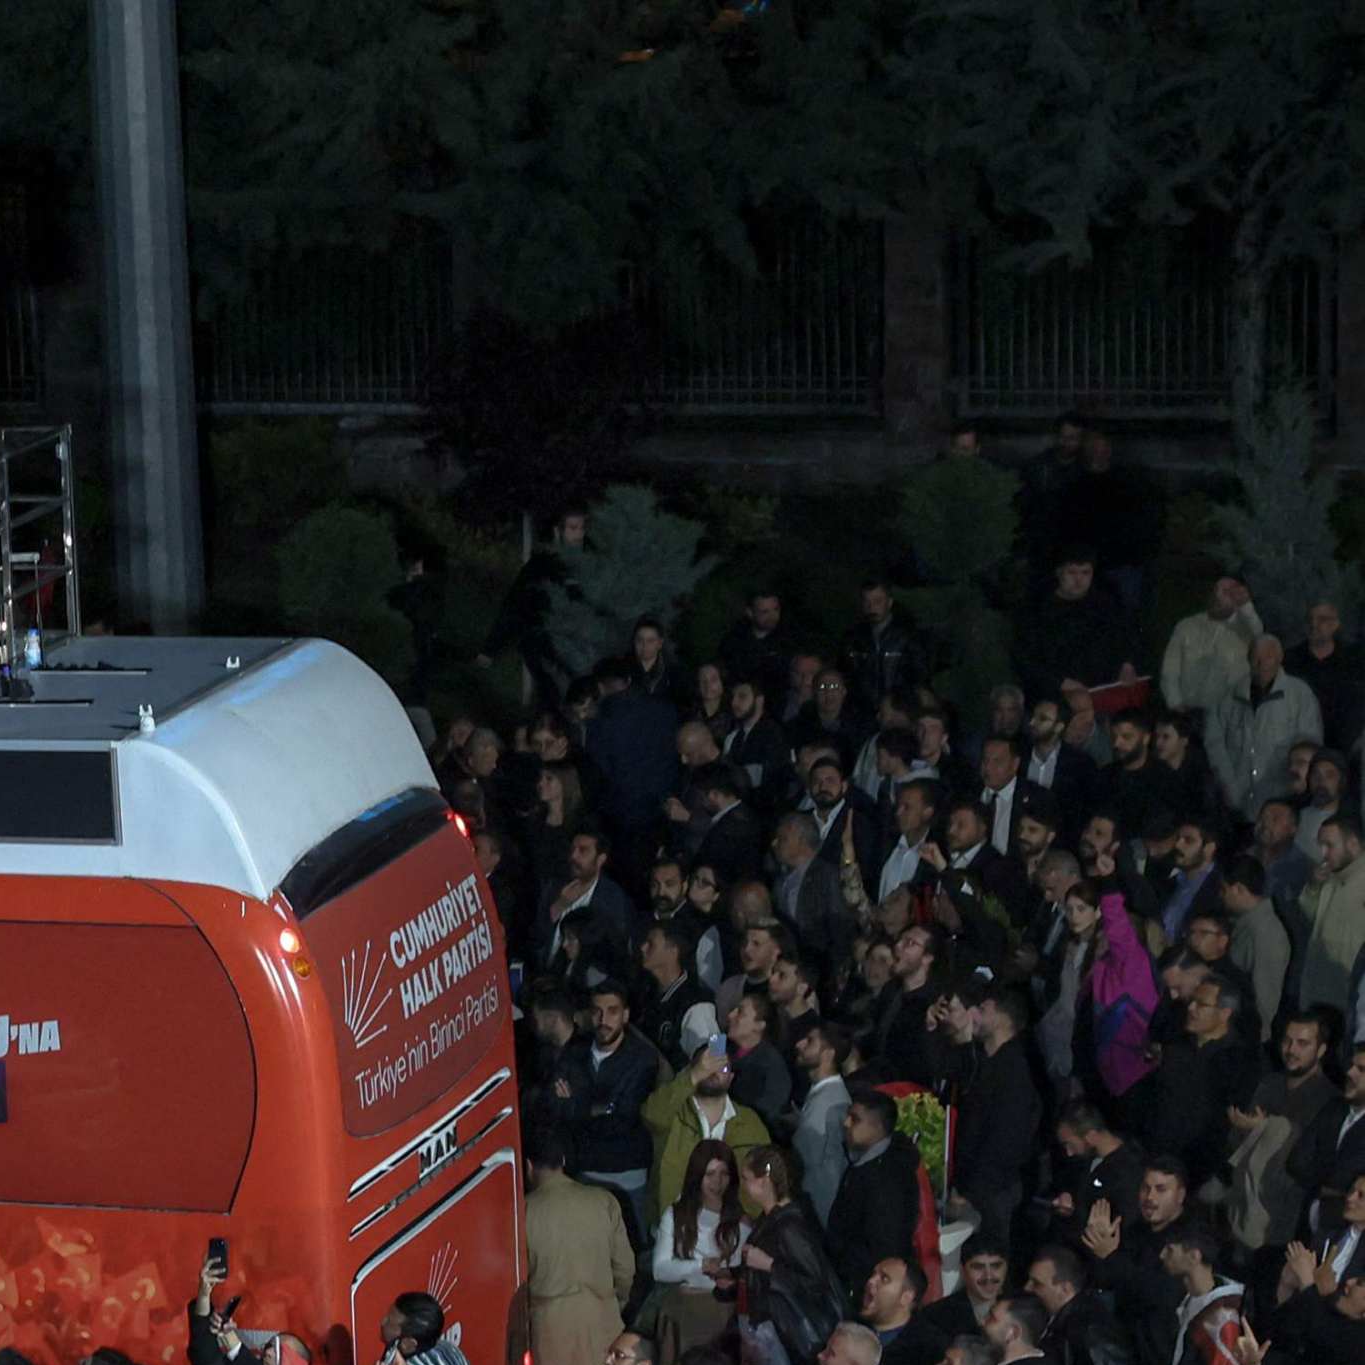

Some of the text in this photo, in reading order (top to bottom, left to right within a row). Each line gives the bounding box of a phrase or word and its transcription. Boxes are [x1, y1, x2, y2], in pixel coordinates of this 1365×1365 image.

[389, 873, 483, 969] CUMHURİYET
[399, 909, 494, 1020] HALK PARTİSİ
[355, 975, 500, 1109] Türkiye'nin Birinci Partisi
[418, 1126, 458, 1175] MAN
